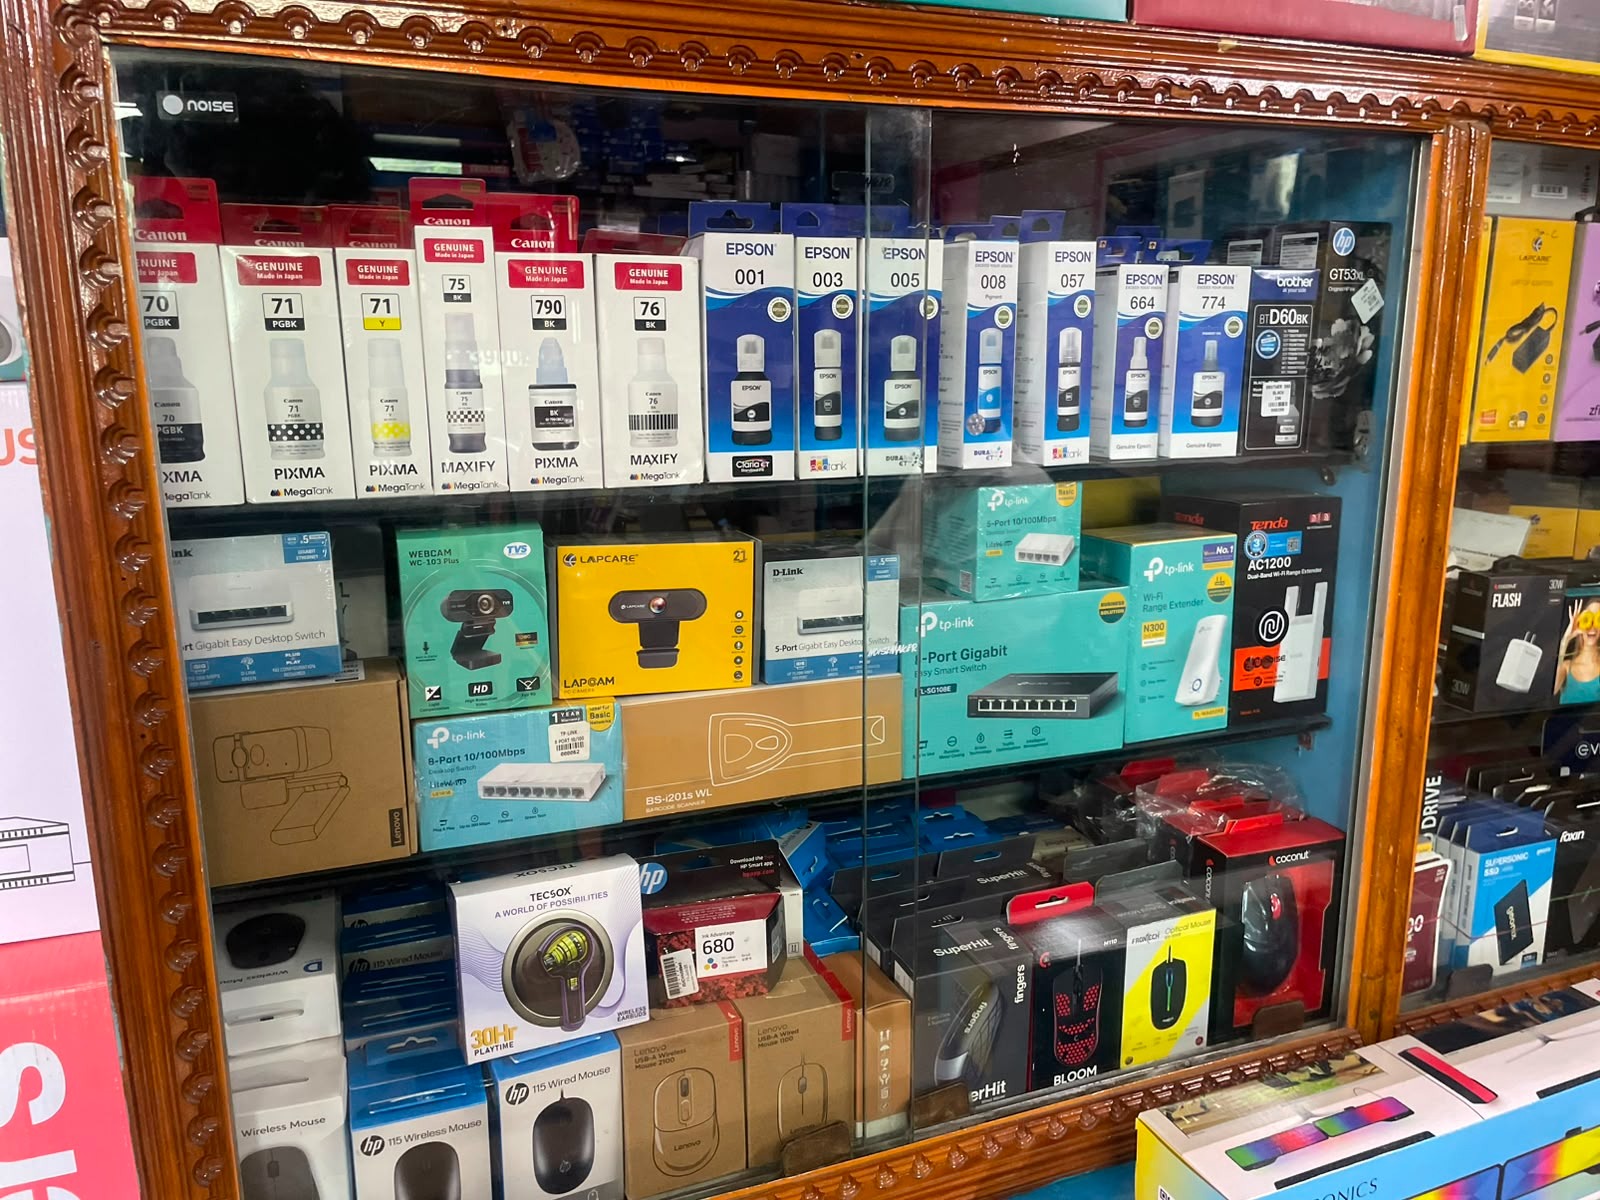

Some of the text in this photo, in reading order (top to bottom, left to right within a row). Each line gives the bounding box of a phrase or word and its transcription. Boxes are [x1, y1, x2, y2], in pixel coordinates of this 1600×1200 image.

[424, 217, 470, 226] Canon
[135, 230, 187, 241] Canon
[1334, 230, 1353, 254] hp
[434, 243, 474, 252] GENUINE
[511, 238, 554, 249] Canon
[725, 242, 774, 256] EPSON
[458, 252, 474, 260] Japan
[805, 247, 850, 259] EPSON
[883, 248, 926, 260] EPSON
[975, 251, 1013, 263] EPSON
[1055, 251, 1092, 263] EPSON
[255, 262, 303, 272] GENUINE
[357, 265, 398, 274] GENUINE
[525, 266, 568, 275] GENUINE
[629, 268, 669, 278] GENUINE
[283, 273, 303, 281] Japan
[551, 275, 568, 284] Japan
[734, 269, 765, 285] 001
[812, 272, 843, 287] 003
[890, 272, 920, 287] 005
[1060, 273, 1085, 288] 057
[1125, 274, 1163, 286] EPSON
[1197, 274, 1235, 285] EPSON
[1329, 268, 1365, 281] GT53XL
[449, 278, 465, 290] 75
[980, 274, 1006, 289] 008
[1277, 276, 1314, 288] brother
[142, 296, 169, 312] 70
[271, 298, 294, 314] 71
[370, 298, 391, 314] 71
[535, 300, 562, 315] 790
[640, 301, 660, 317] 76
[1130, 296, 1155, 310] 664
[1202, 296, 1226, 310] 774
[145, 318, 171, 327] PGBK
[272, 320, 298, 329] PGBK
[544, 320, 555, 328] BK
[646, 321, 656, 329] BK
[648, 397, 658, 405] 76
[288, 405, 299, 413] 71
[163, 414, 175, 422] 70
[535, 457, 579, 469] PIXMA
[630, 453, 679, 466] MAXIFY
[274, 467, 326, 480] PIXMA
[369, 463, 418, 476] PIXMA
[441, 461, 496, 475] MAXIFY
[542, 475, 585, 485] MegaTank
[640, 471, 681, 481] MegaTank
[284, 486, 334, 497] MegaTank
[378, 481, 426, 493] MegaTank
[454, 480, 500, 491] MegaTank
[1004, 496, 1029, 507] tp-link
[987, 516, 1057, 527] 5-Port 10/100Mbps
[1250, 517, 1289, 530] Tenda
[409, 549, 452, 558] WEBCAM
[507, 545, 527, 554] TVS
[409, 559, 442, 567] WC-103
[580, 554, 635, 564] LAPCARE
[1248, 556, 1291, 571] AC1200
[772, 568, 804, 577] D-Link
[1165, 562, 1194, 575] tp-link
[1247, 567, 1322, 580] Dual-Band Wi-Fi Range Extender
[1143, 593, 1164, 601] Wi-Fi
[1492, 593, 1522, 608] FLASH
[1143, 598, 1204, 613] Range Extender
[939, 616, 974, 631] tp-link
[1143, 623, 1165, 632] N300
[195, 630, 326, 651] Gigabit Easy Desktop Switch
[775, 645, 797, 653] 5-Port
[798, 642, 823, 652] Gigabit
[823, 640, 838, 649] Easy
[839, 639, 866, 649] Deskto
[960, 645, 1008, 661] Gigabit
[934, 663, 987, 676] Smart Switch
[473, 684, 488, 694] HD
[551, 712, 558, 723] 1
[589, 711, 611, 719] Basic
[451, 729, 486, 743] tp-link
[428, 748, 526, 766] 8-Port 10/100Mbps
[646, 788, 712, 806] BS-i201s WL
[1421, 775, 1442, 830] DRIVE
[645, 800, 706, 814] BARCODE SCANNER
[393, 811, 401, 844] Lenovo
[1560, 831, 1585, 843] foxin
[1276, 850, 1309, 864] coconut
[1485, 852, 1529, 867] SUPERSONIC
[976, 869, 1028, 885] SuperHit
[1484, 867, 1499, 877] SSD
[638, 864, 665, 894] hp
[530, 886, 572, 902] TECSOX
[494, 890, 609, 919] A WORLD OF POSSIBILITIES
[1165, 919, 1212, 936] Optical Mouse
[993, 927, 1019, 950] fingers
[702, 937, 735, 955] 680
[933, 938, 992, 957] SuperHit
[1014, 964, 1025, 1004] fingers
[617, 1006, 646, 1017] WIRELESS
[617, 1011, 647, 1022] EARBUDS
[963, 1001, 987, 1034] fingers
[757, 1023, 788, 1036] Lenovo
[758, 1028, 800, 1043] USB-A Wired
[470, 1024, 518, 1049] 30Hr
[474, 1041, 514, 1057] PLAYTIME
[634, 1044, 667, 1056] Lenovo
[757, 1039, 779, 1049] Mouse
[635, 1048, 686, 1065] USB-A Wireless
[635, 1057, 675, 1070] Mouse 2100
[1054, 1065, 1098, 1087] BLOOM
[505, 1065, 611, 1106] hp 115 Wired Mouse
[241, 1116, 326, 1138] Wireless Mouse
[361, 1119, 482, 1156] hp 115 Wireless Mouse
[674, 1139, 701, 1151] Lenovo
